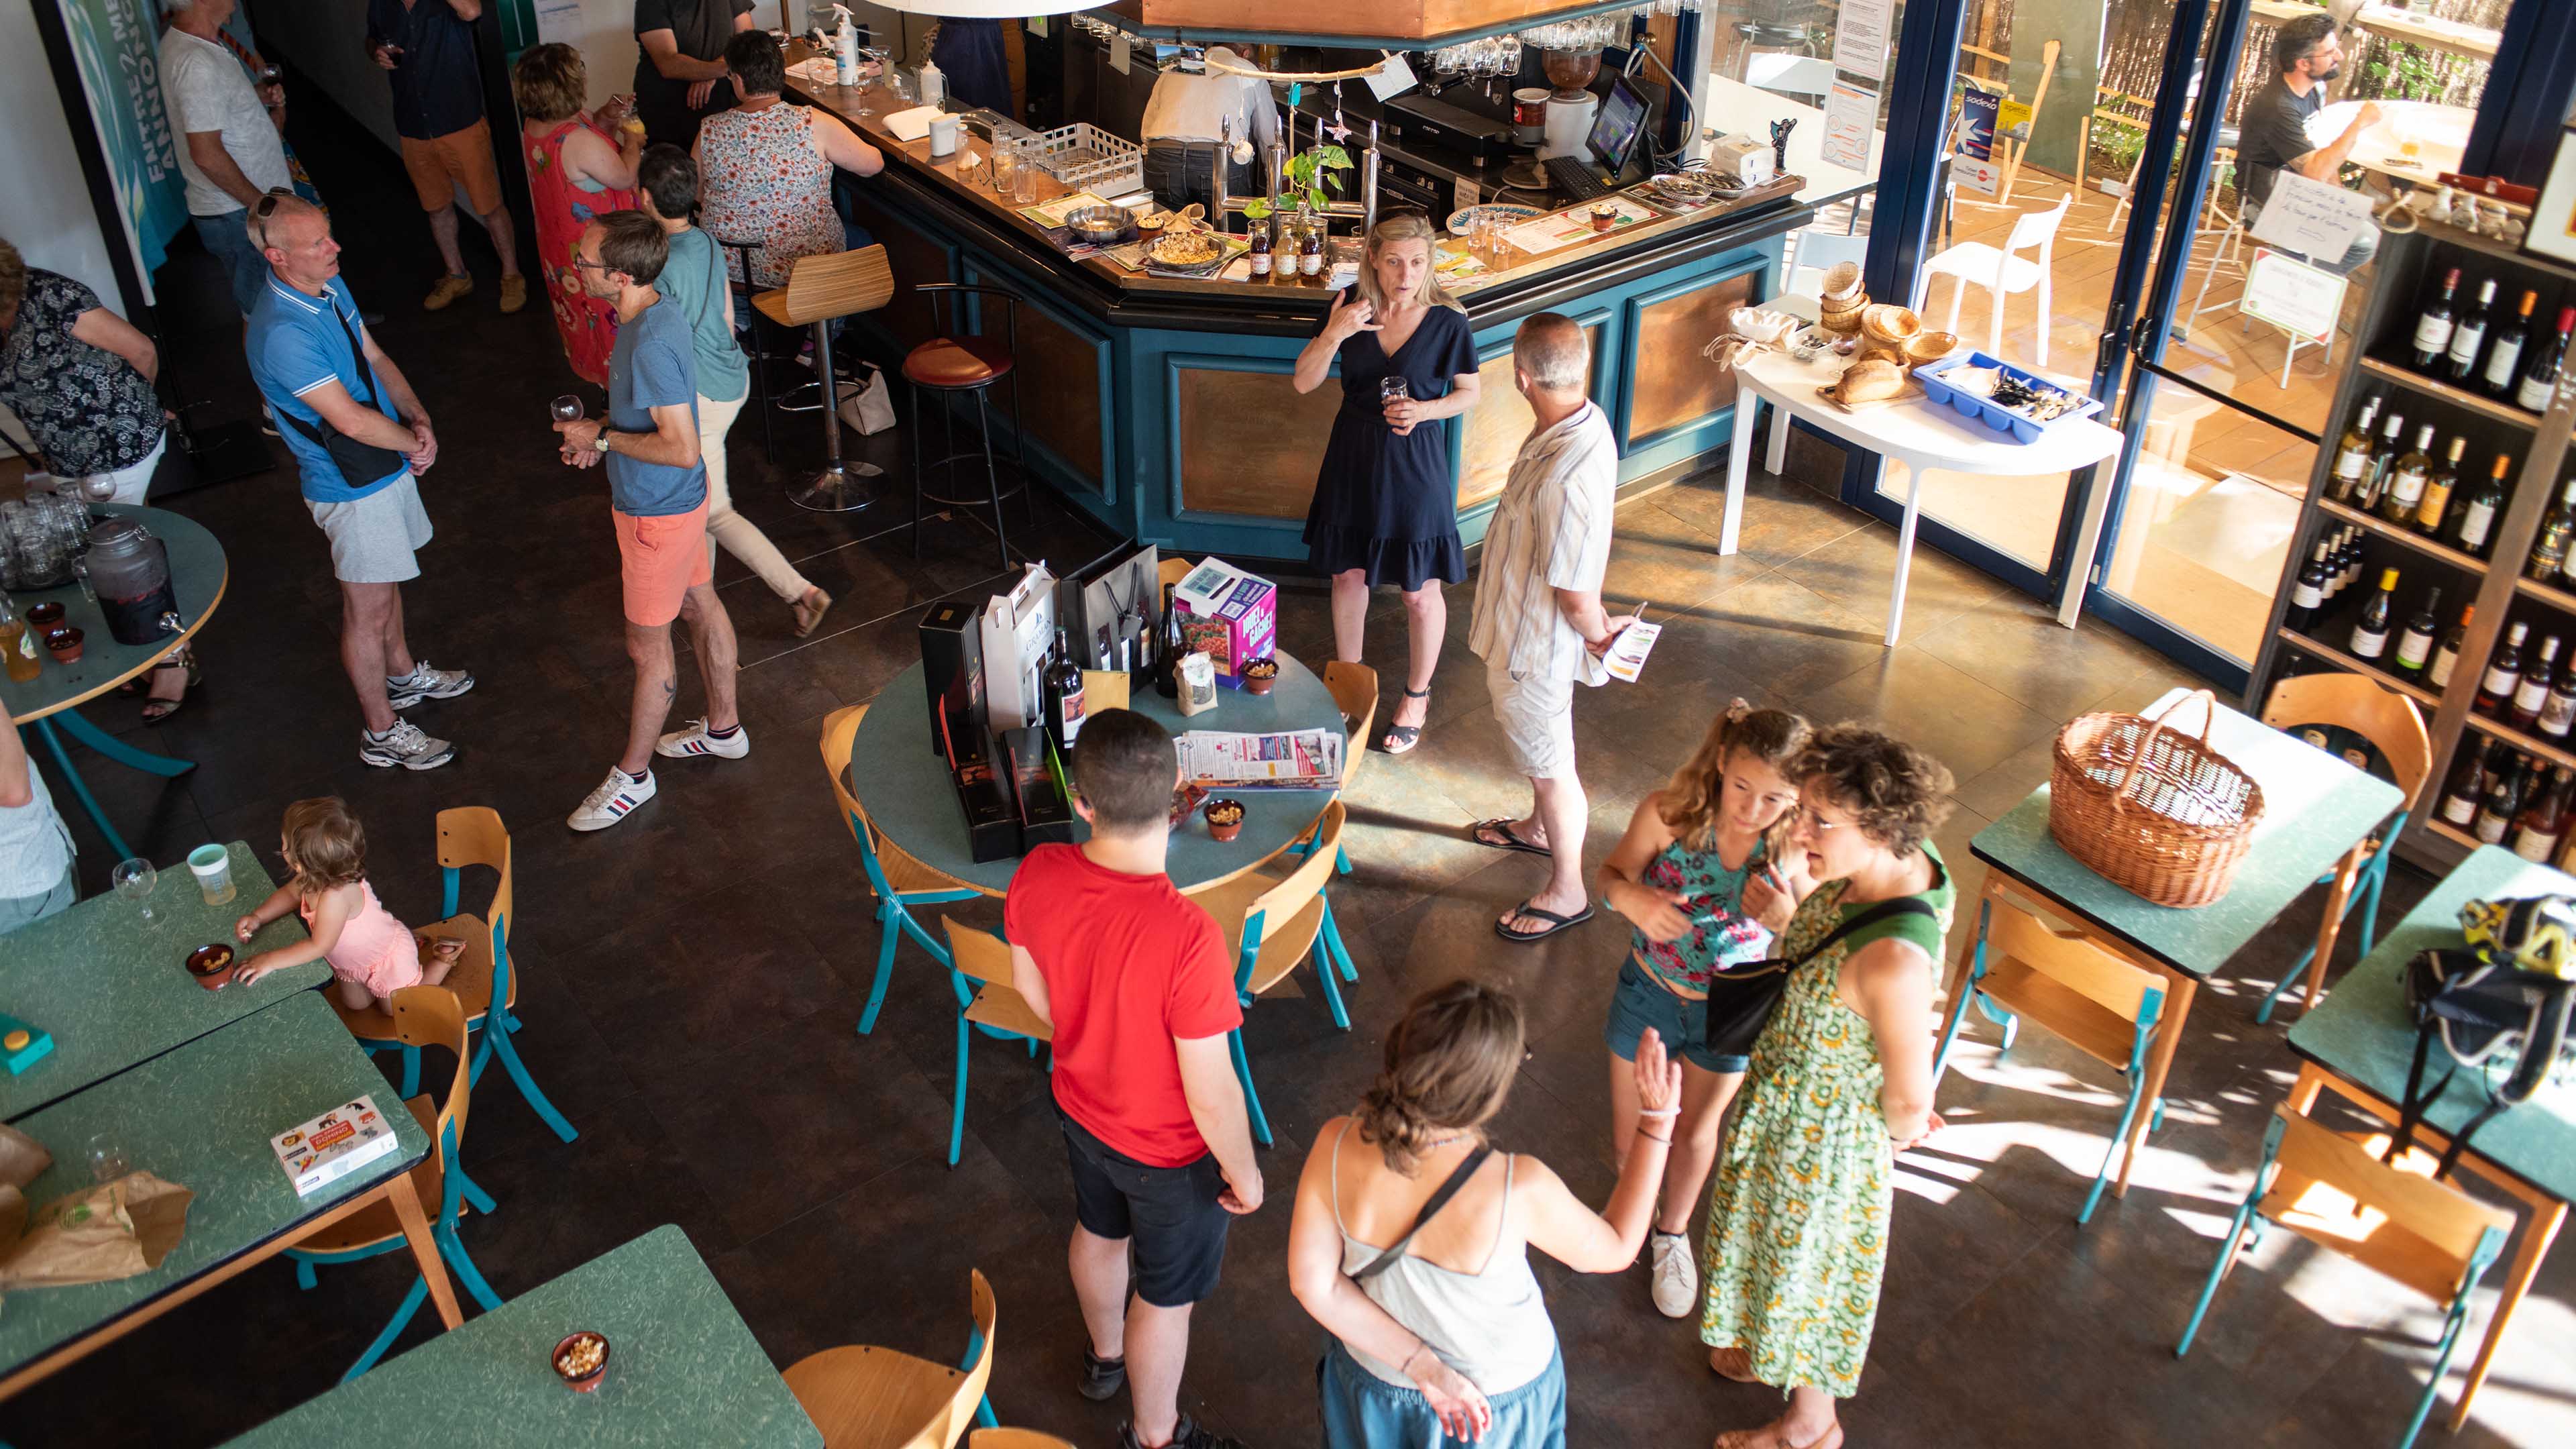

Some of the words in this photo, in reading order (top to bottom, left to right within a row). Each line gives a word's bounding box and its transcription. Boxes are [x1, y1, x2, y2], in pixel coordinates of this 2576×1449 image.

[1965, 95, 1997, 110] sodexo
[127, 74, 166, 184] ENTRE
[1243, 605, 1260, 639] JOUEZ
[1249, 610, 1273, 648] GAGNEZ
[315, 1126, 349, 1145] DOMINO
